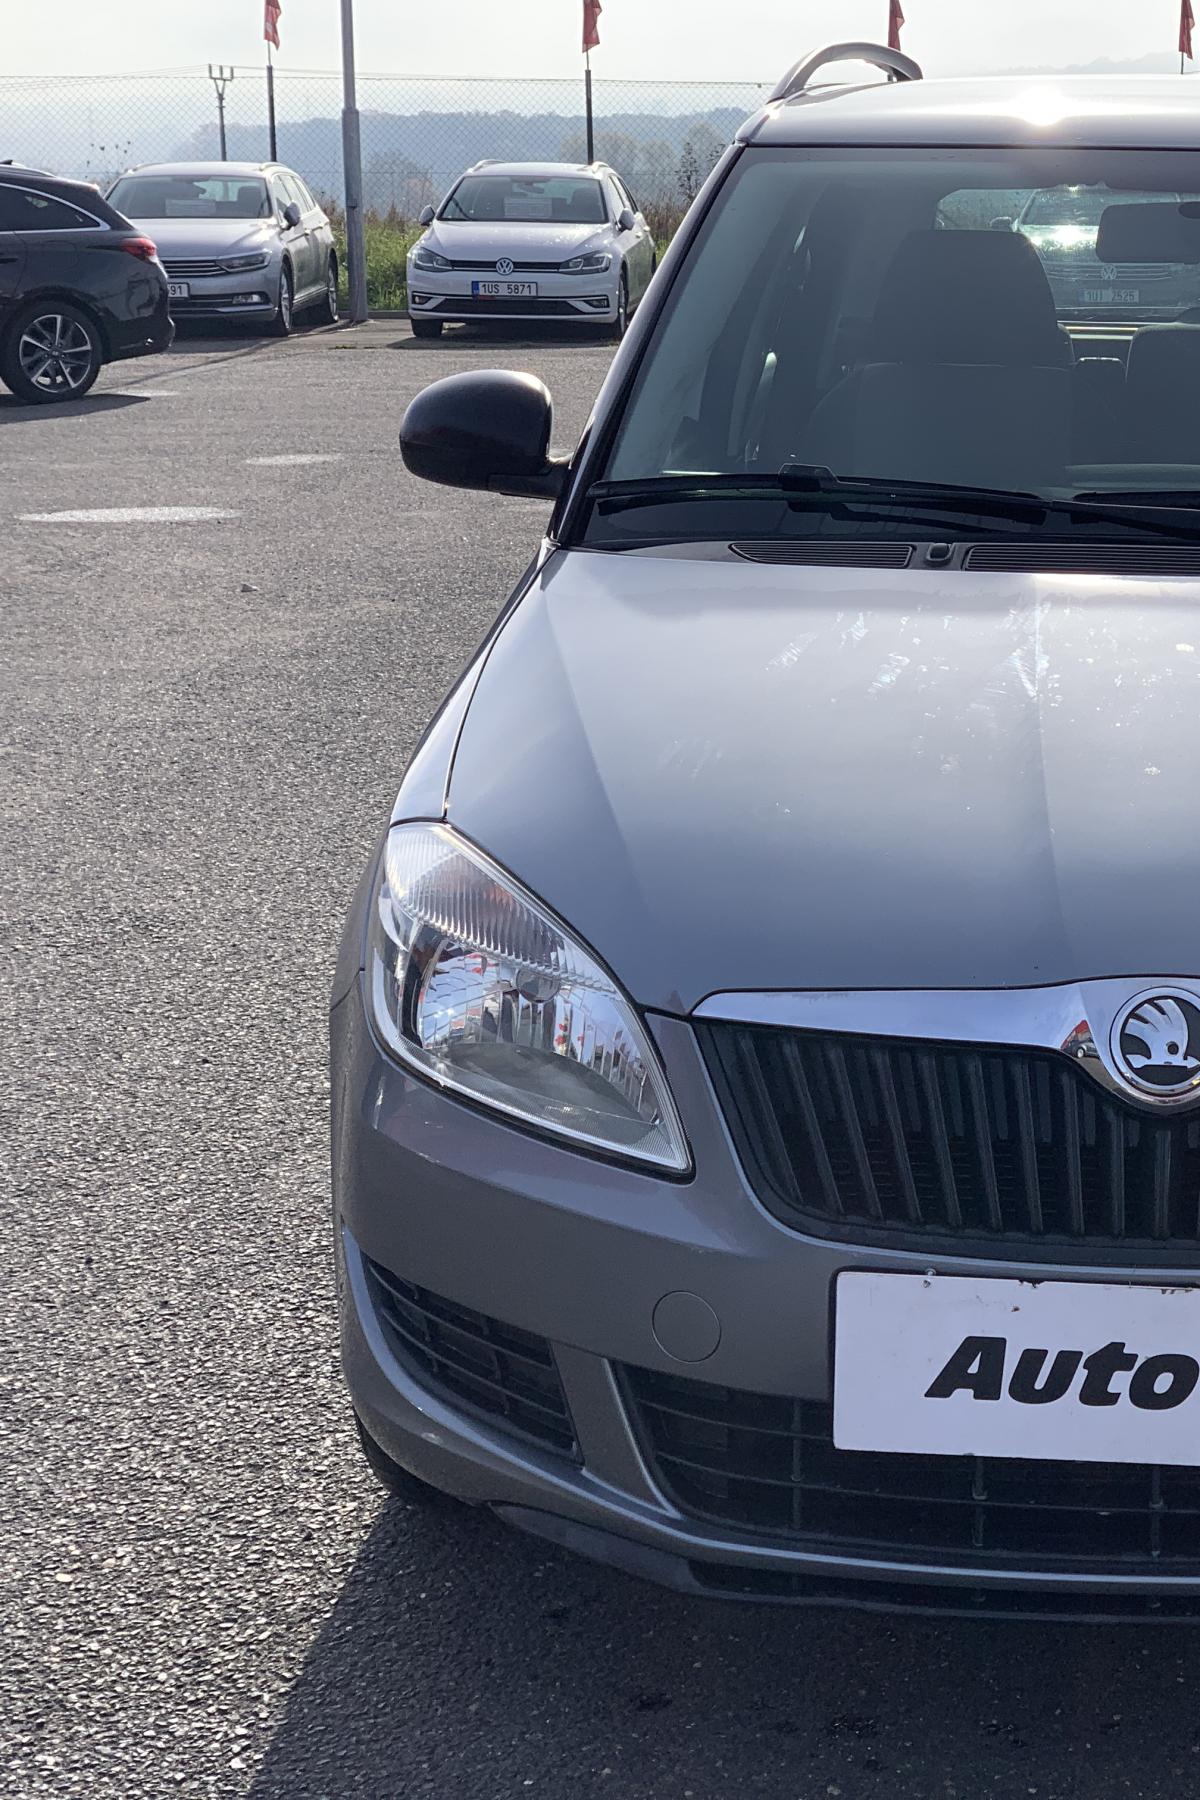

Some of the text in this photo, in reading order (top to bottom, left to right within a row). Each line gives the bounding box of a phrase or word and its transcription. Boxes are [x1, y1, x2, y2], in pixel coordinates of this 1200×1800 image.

[481, 283, 532, 295] 1US 5871
[924, 1335, 1200, 1410] Auto
